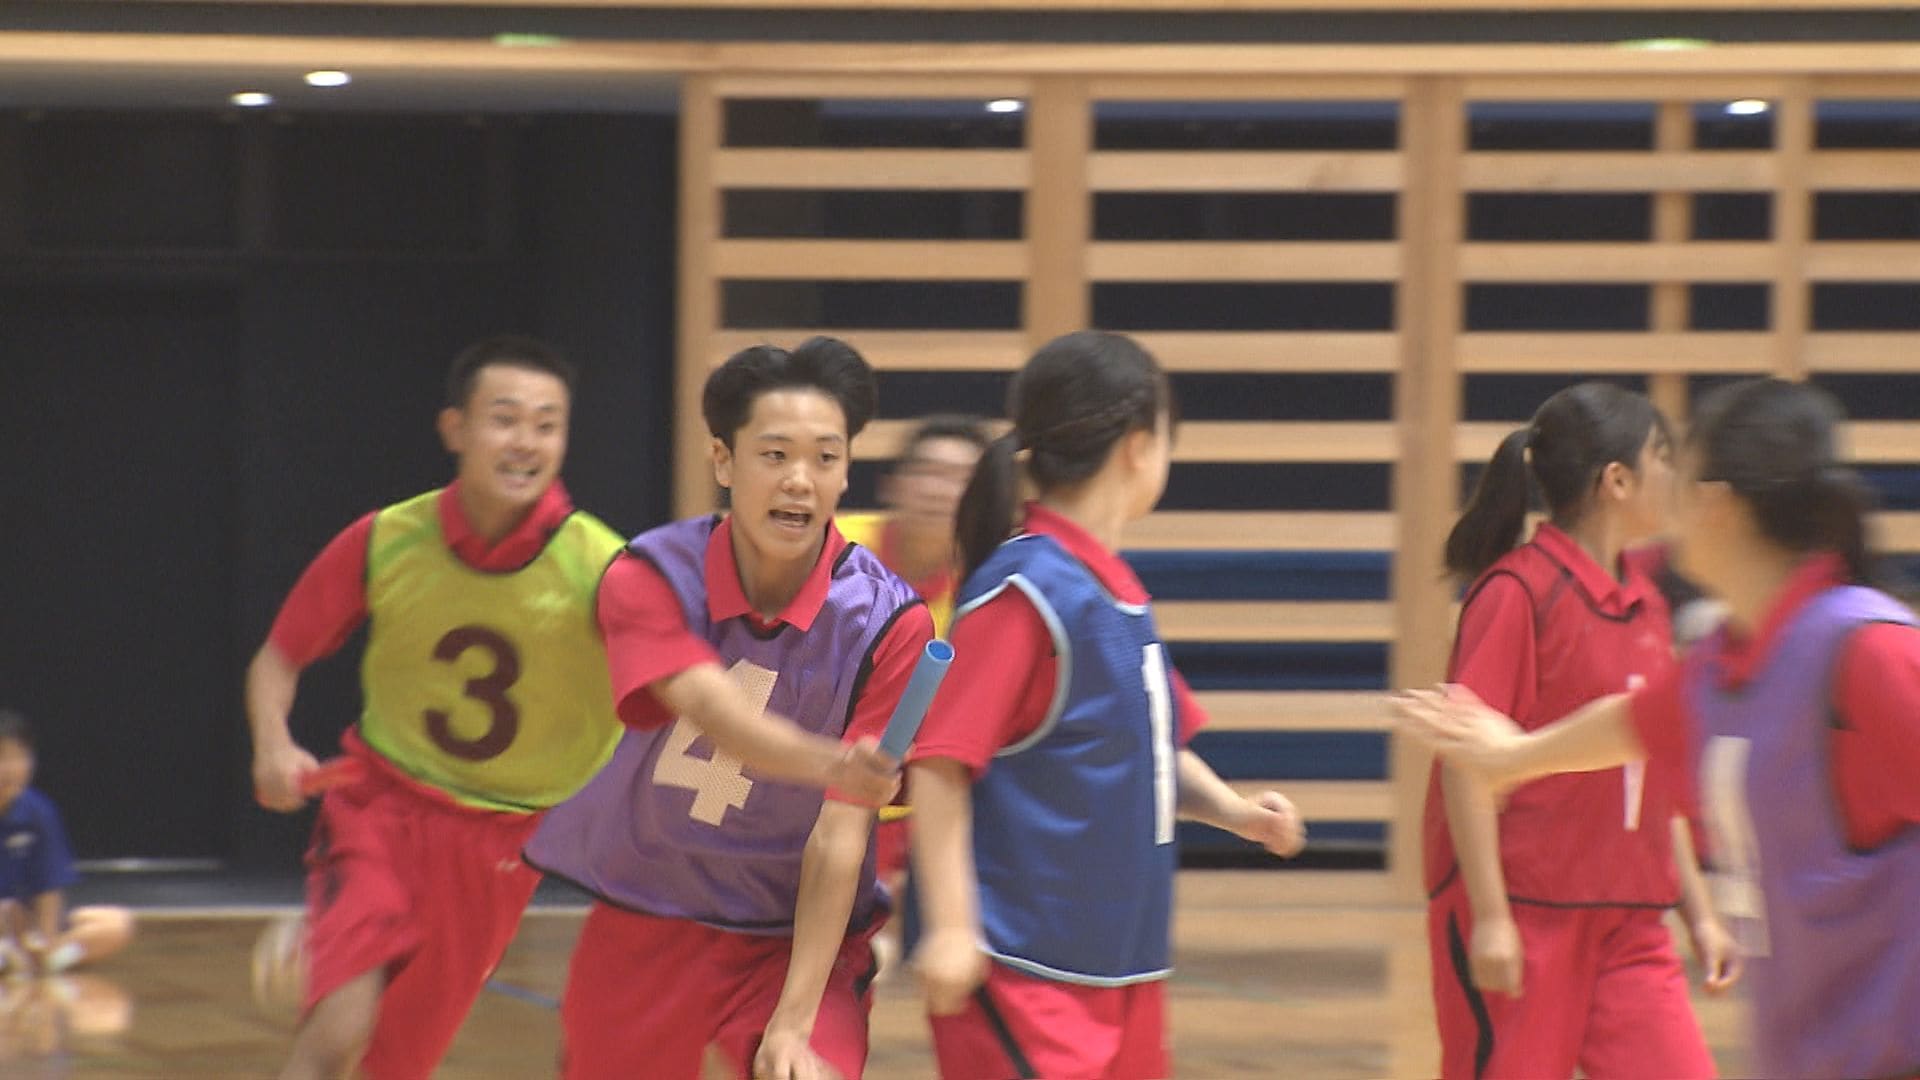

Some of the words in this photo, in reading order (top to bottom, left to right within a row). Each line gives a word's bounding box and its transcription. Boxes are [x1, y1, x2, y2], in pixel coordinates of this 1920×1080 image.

[423, 625, 521, 762] 3
[653, 658, 778, 826] 4
[1142, 643, 1177, 845] 1
